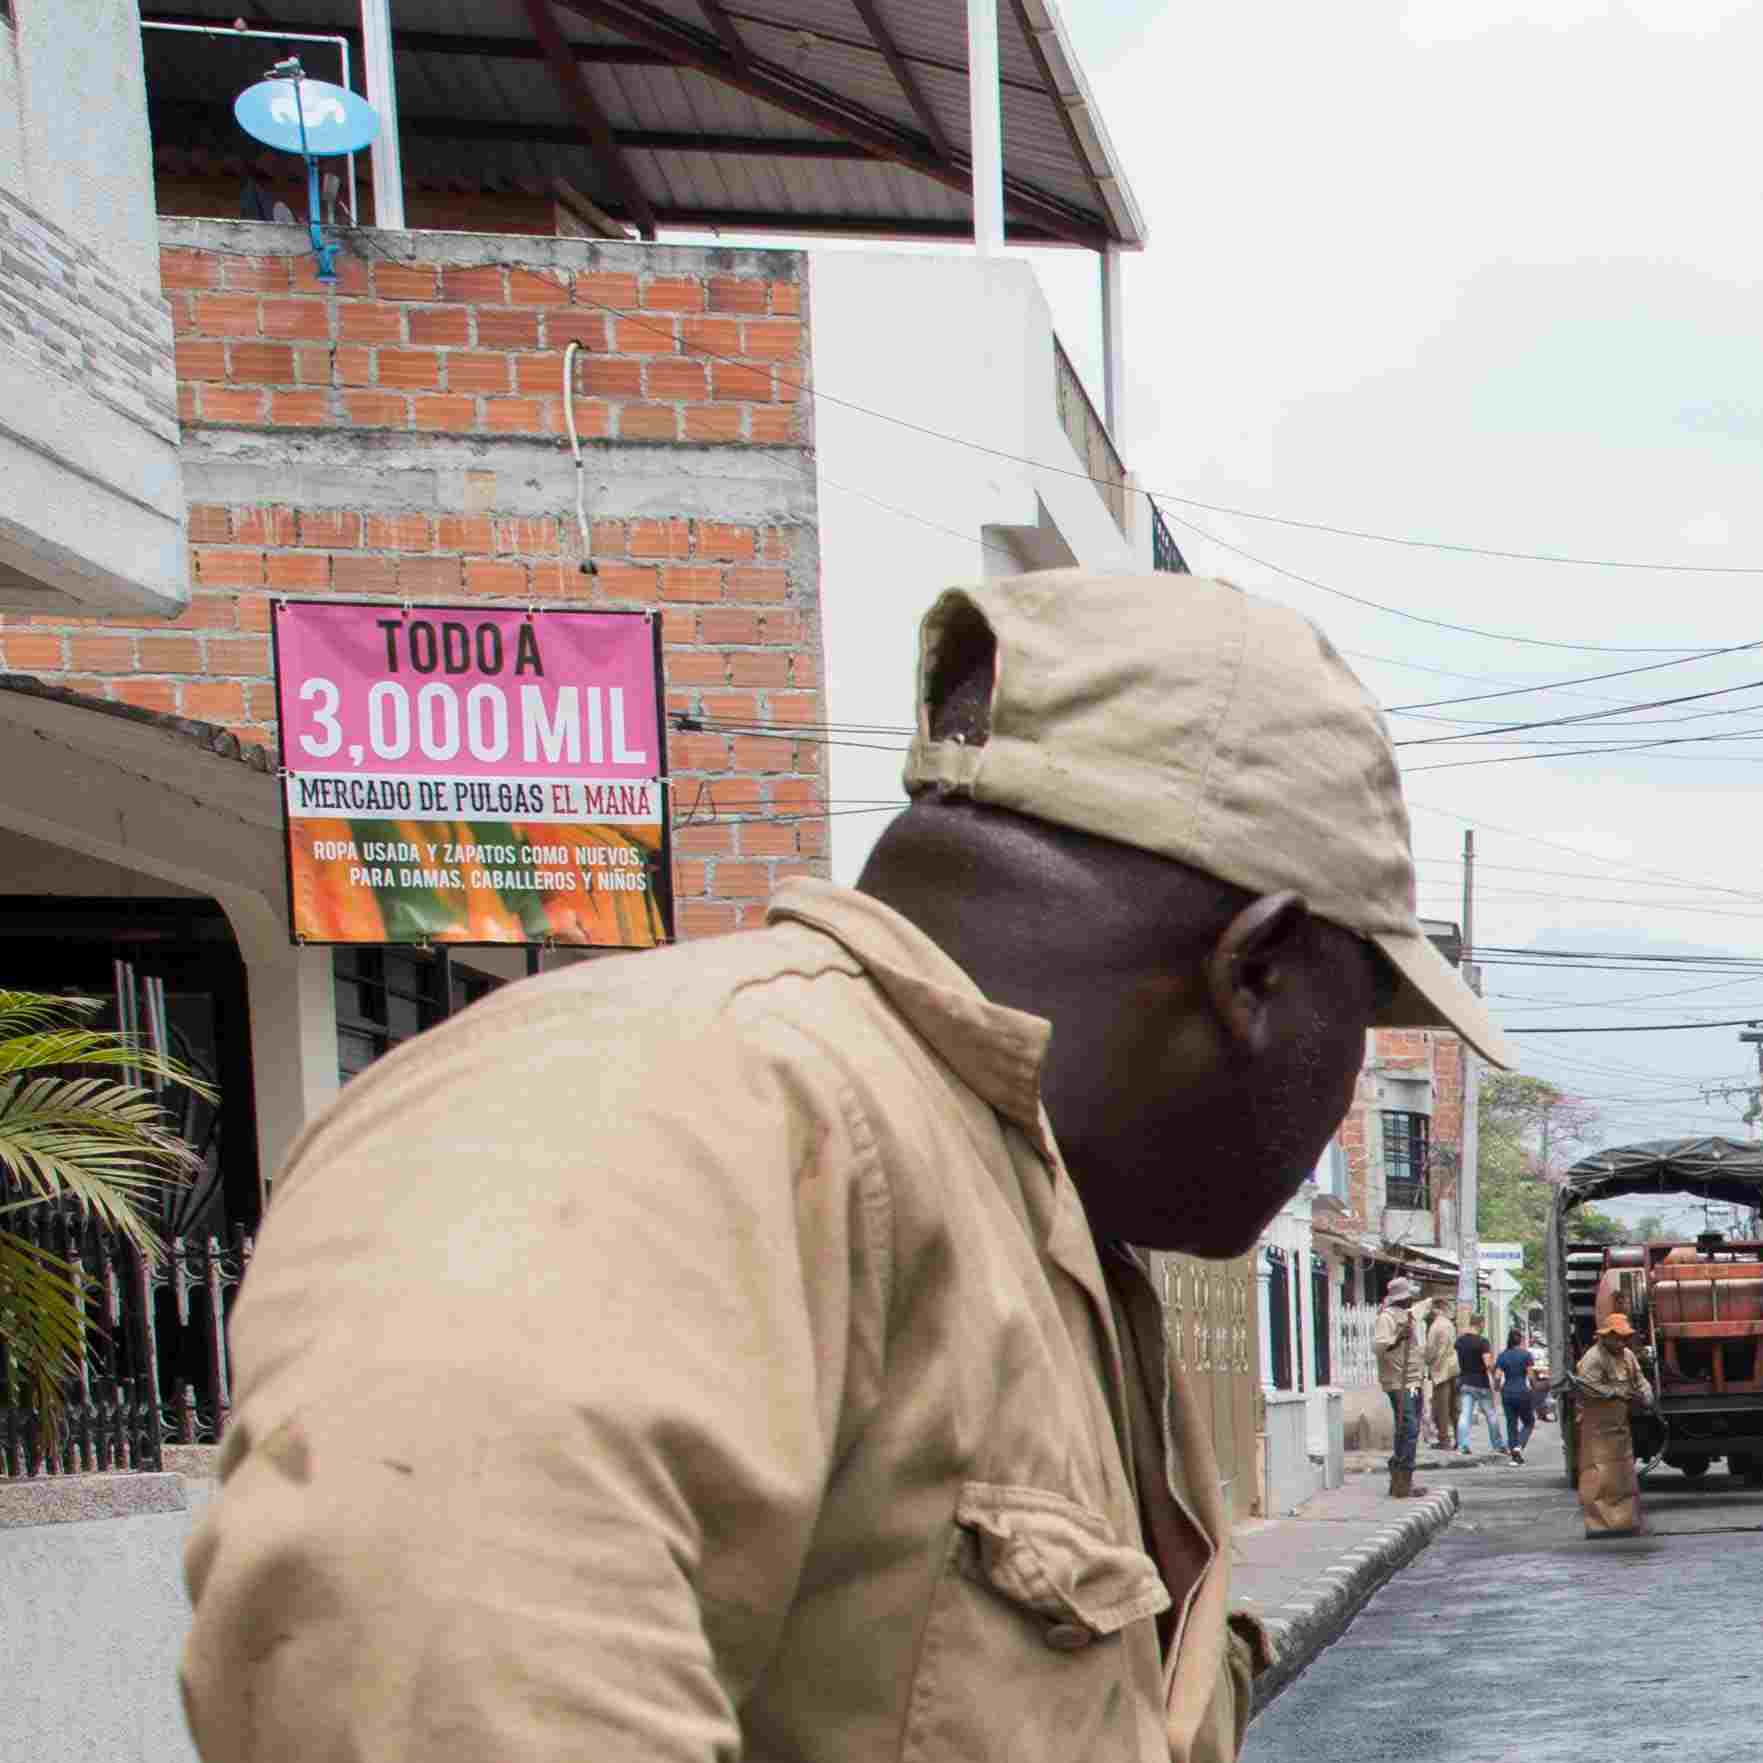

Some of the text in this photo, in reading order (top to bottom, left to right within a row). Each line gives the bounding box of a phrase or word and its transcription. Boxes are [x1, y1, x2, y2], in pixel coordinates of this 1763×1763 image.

[377, 619, 545, 677] TODO A
[298, 677, 647, 767] 3,000 MIL
[299, 778, 411, 811] MERCADO
[418, 781, 449, 812] DE
[453, 782, 544, 814] PULGAS
[551, 784, 579, 814] EL
[312, 840, 359, 861] ROPA
[363, 842, 421, 863] USADA
[426, 843, 438, 862] Y
[443, 844, 517, 865] ZAPATOS
[521, 845, 569, 865] COMO
[350, 867, 647, 891] PARA DAMAS, CABALLEROS Y NIÑOS
